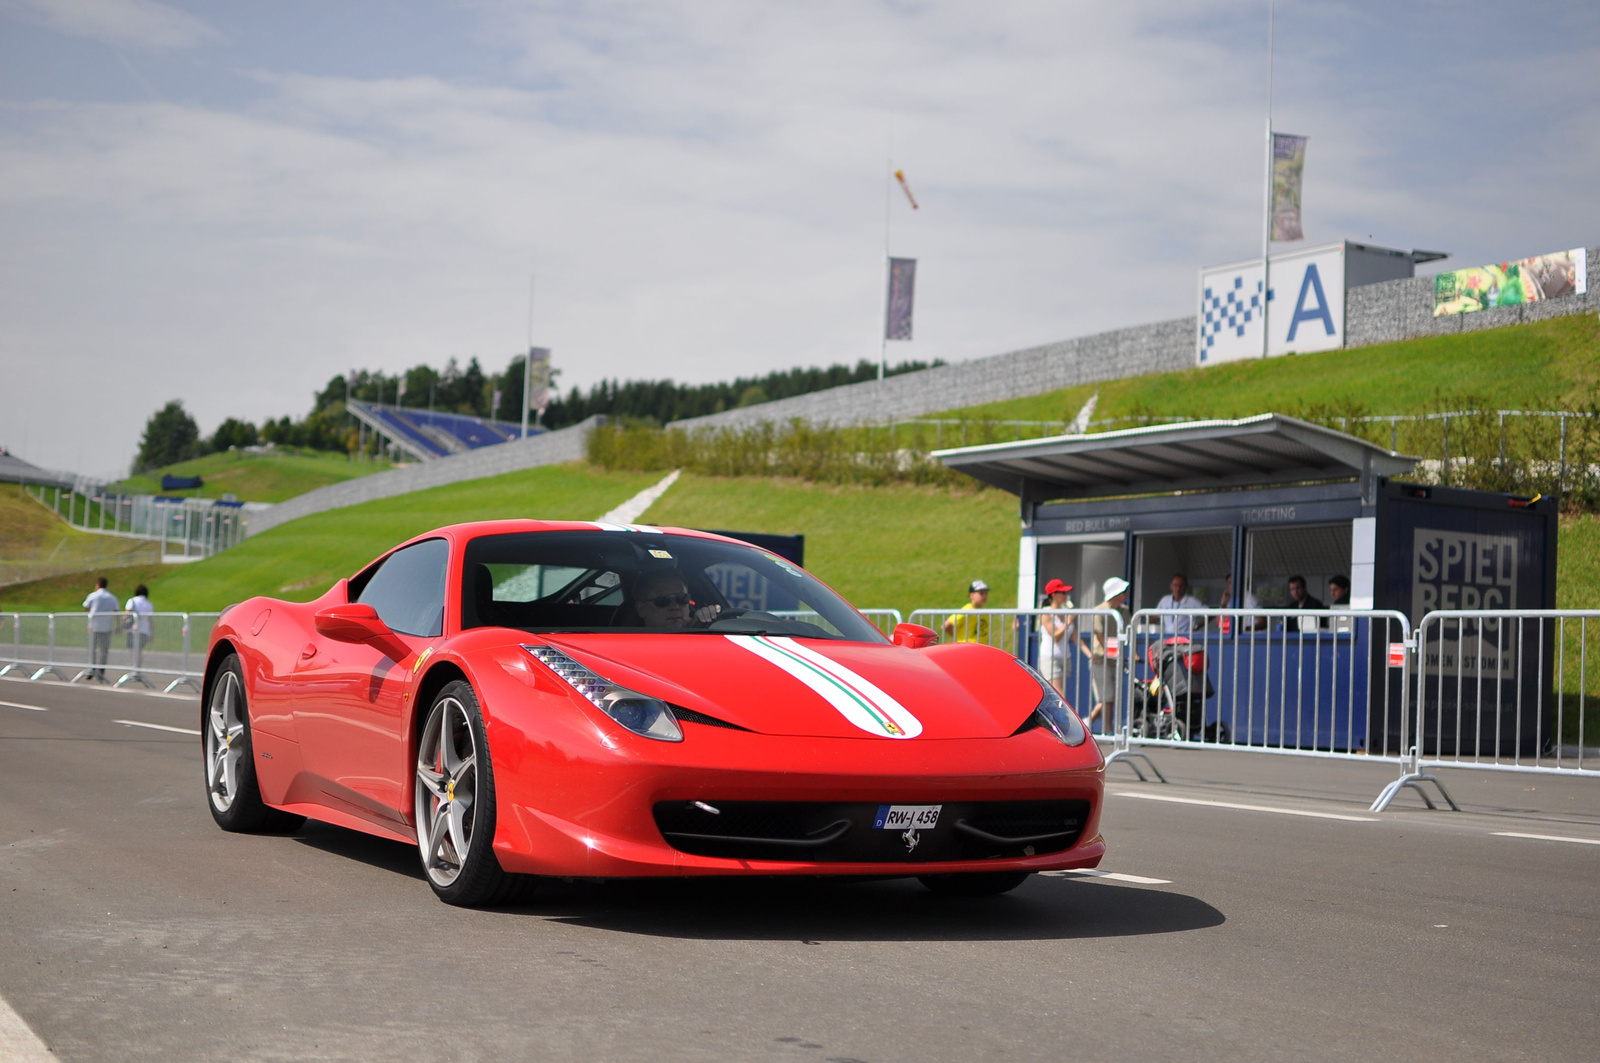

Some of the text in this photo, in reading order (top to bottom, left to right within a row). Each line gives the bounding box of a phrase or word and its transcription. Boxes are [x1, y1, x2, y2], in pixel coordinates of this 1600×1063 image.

[1286, 263, 1336, 342] A
[1242, 507, 1296, 522] TICKETING
[1065, 517, 1131, 533] RED BULL RING
[1419, 537, 1512, 586] SPIEL
[916, 810, 939, 825] 458
